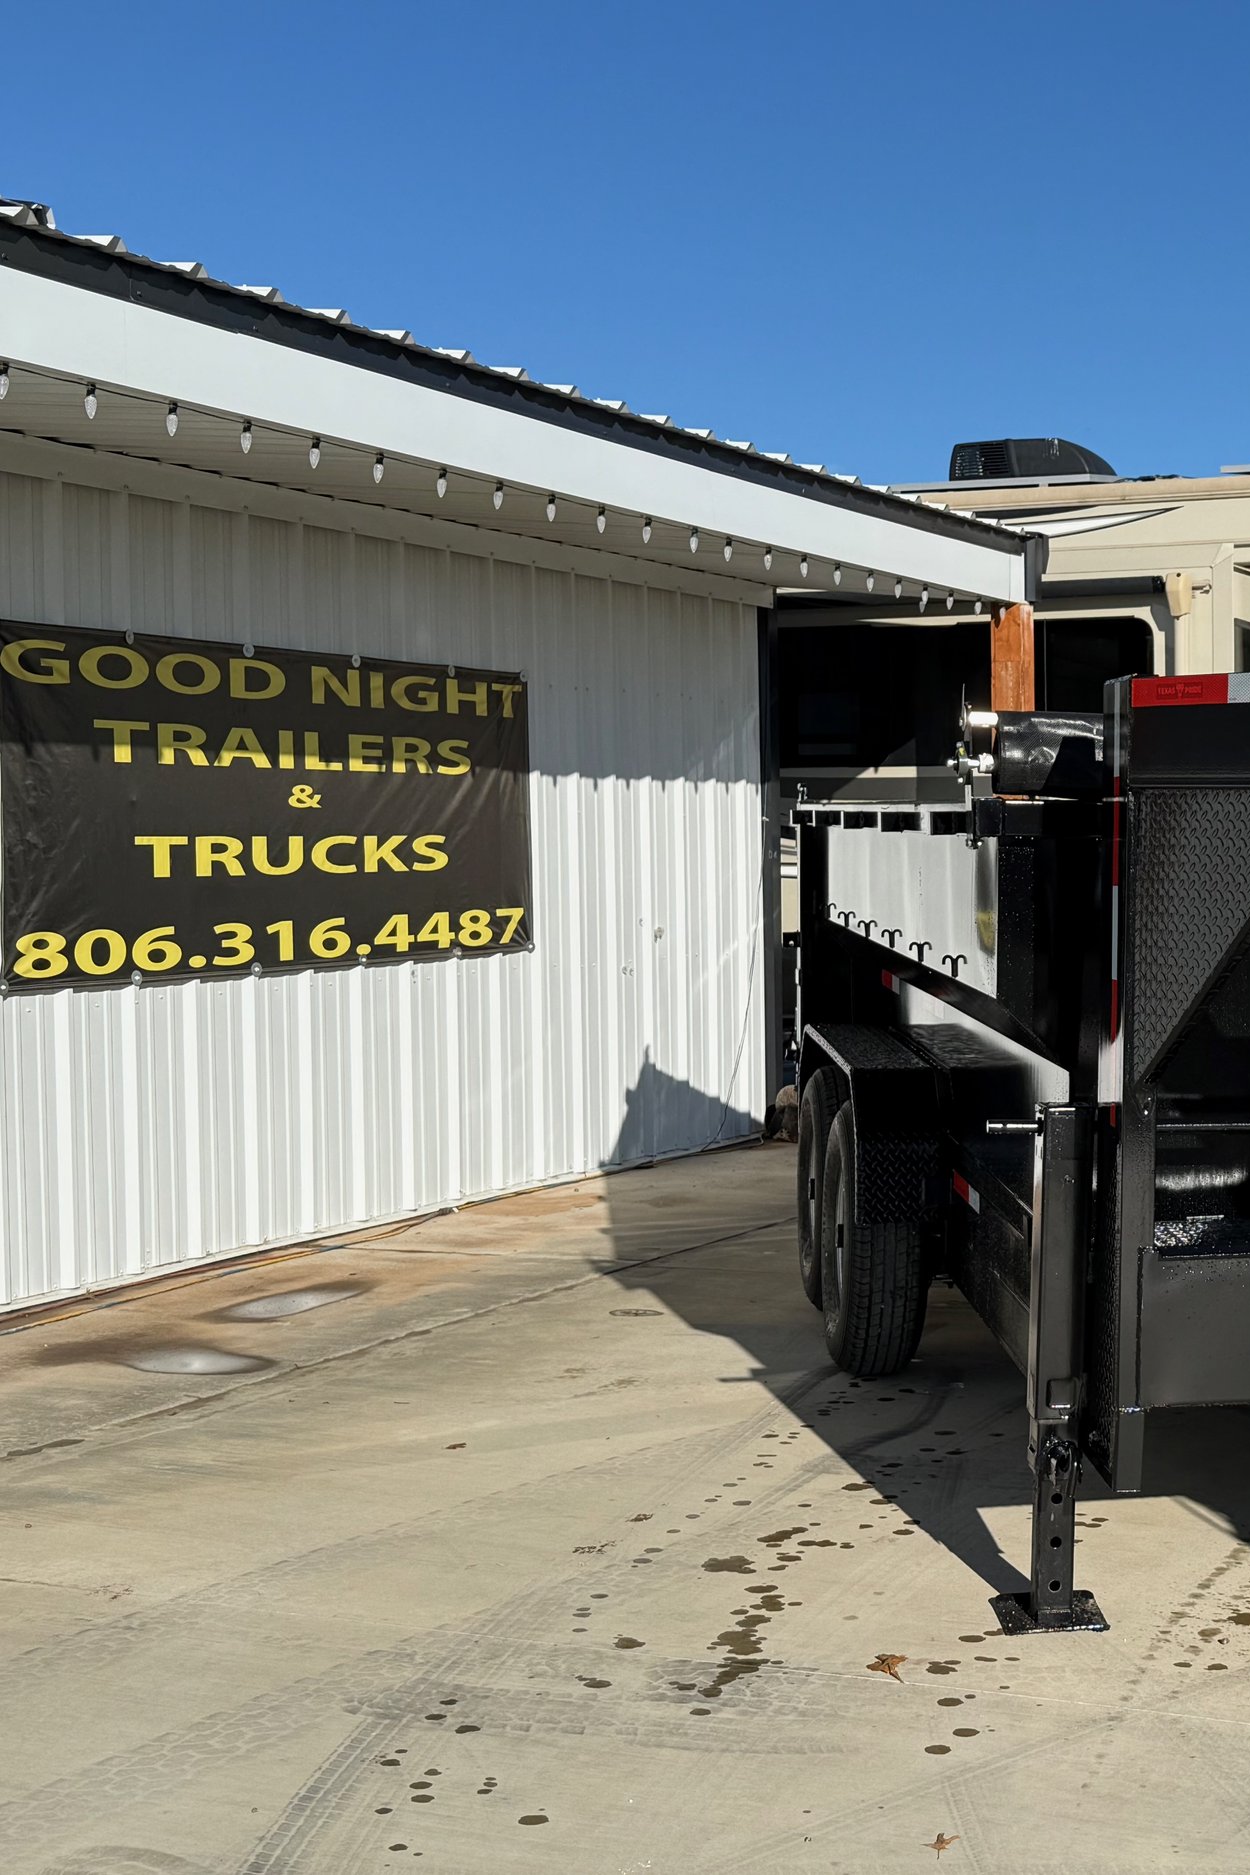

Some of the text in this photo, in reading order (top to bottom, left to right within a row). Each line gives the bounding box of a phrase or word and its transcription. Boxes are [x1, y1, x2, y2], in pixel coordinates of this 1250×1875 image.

[0, 639, 522, 718] GOOD NIGHT
[93, 718, 472, 776] TRAILERS
[287, 784, 322, 809] &
[134, 834, 450, 878] TRUCKS
[12, 906, 525, 979] 806.316.4487
